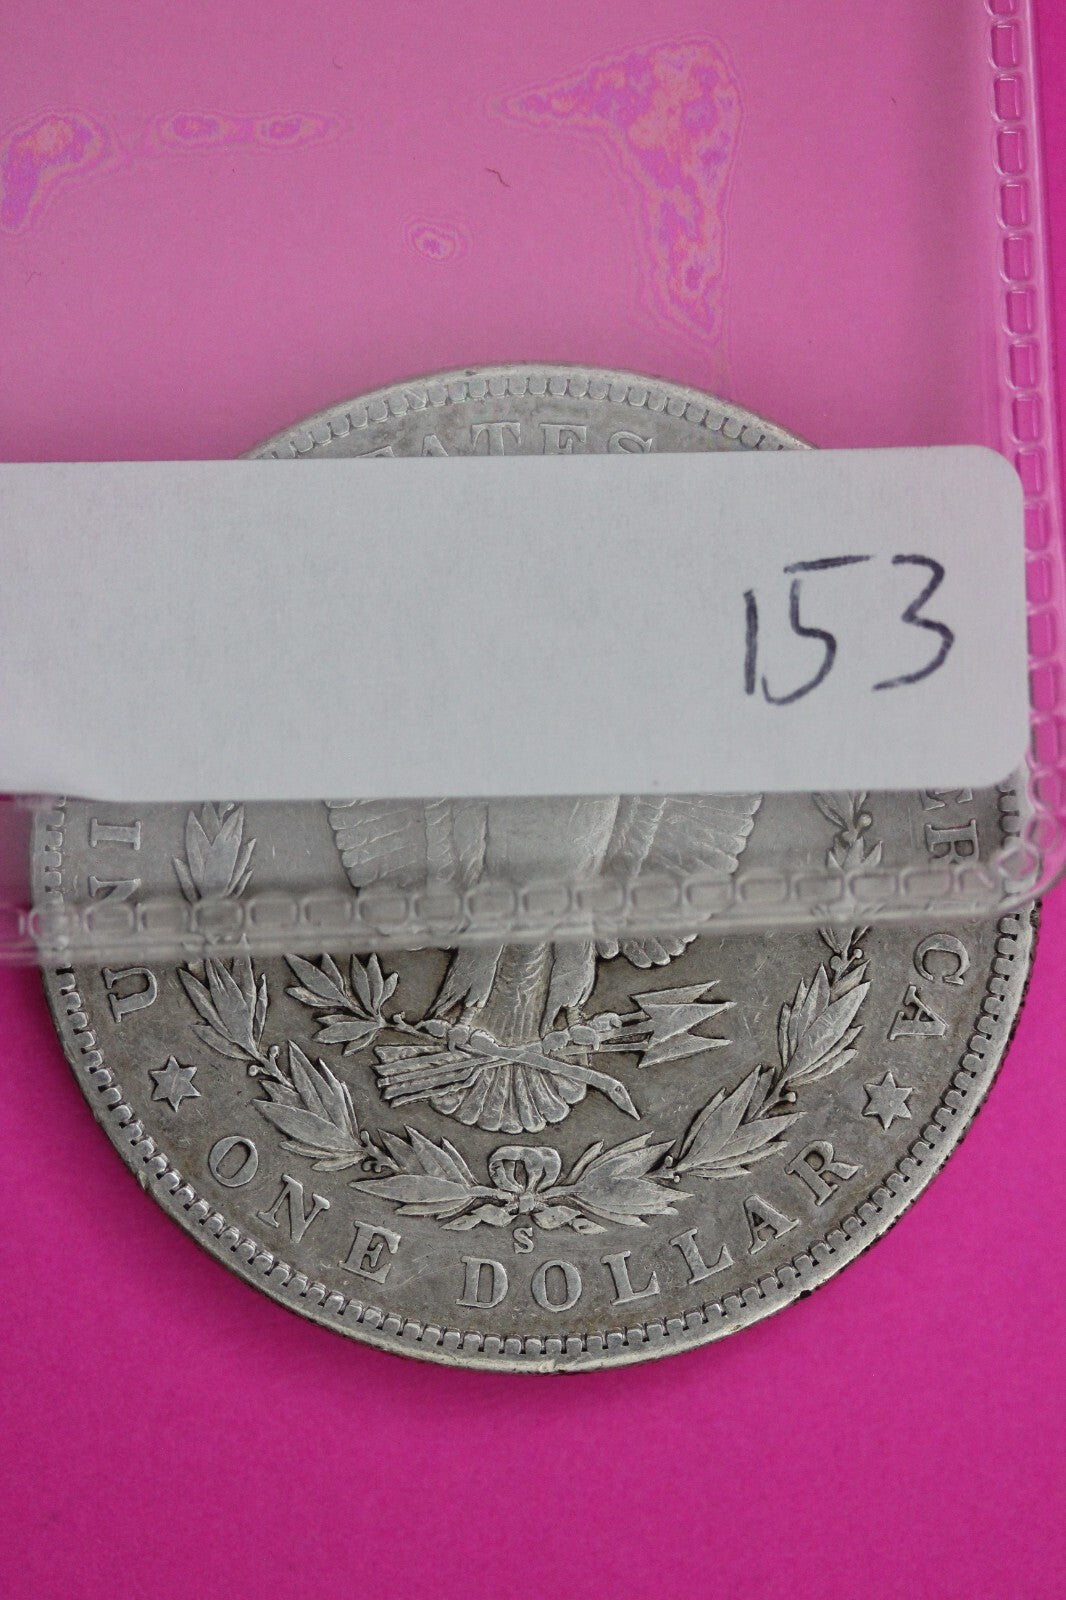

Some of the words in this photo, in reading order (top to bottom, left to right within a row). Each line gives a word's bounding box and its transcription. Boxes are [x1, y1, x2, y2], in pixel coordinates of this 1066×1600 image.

[743, 554, 955, 706] 153
[89, 817, 158, 1023] UNI
[208, 1135, 402, 1285] ONE
[456, 1139, 863, 1312] DOLLAR
[512, 1226, 535, 1255] S
